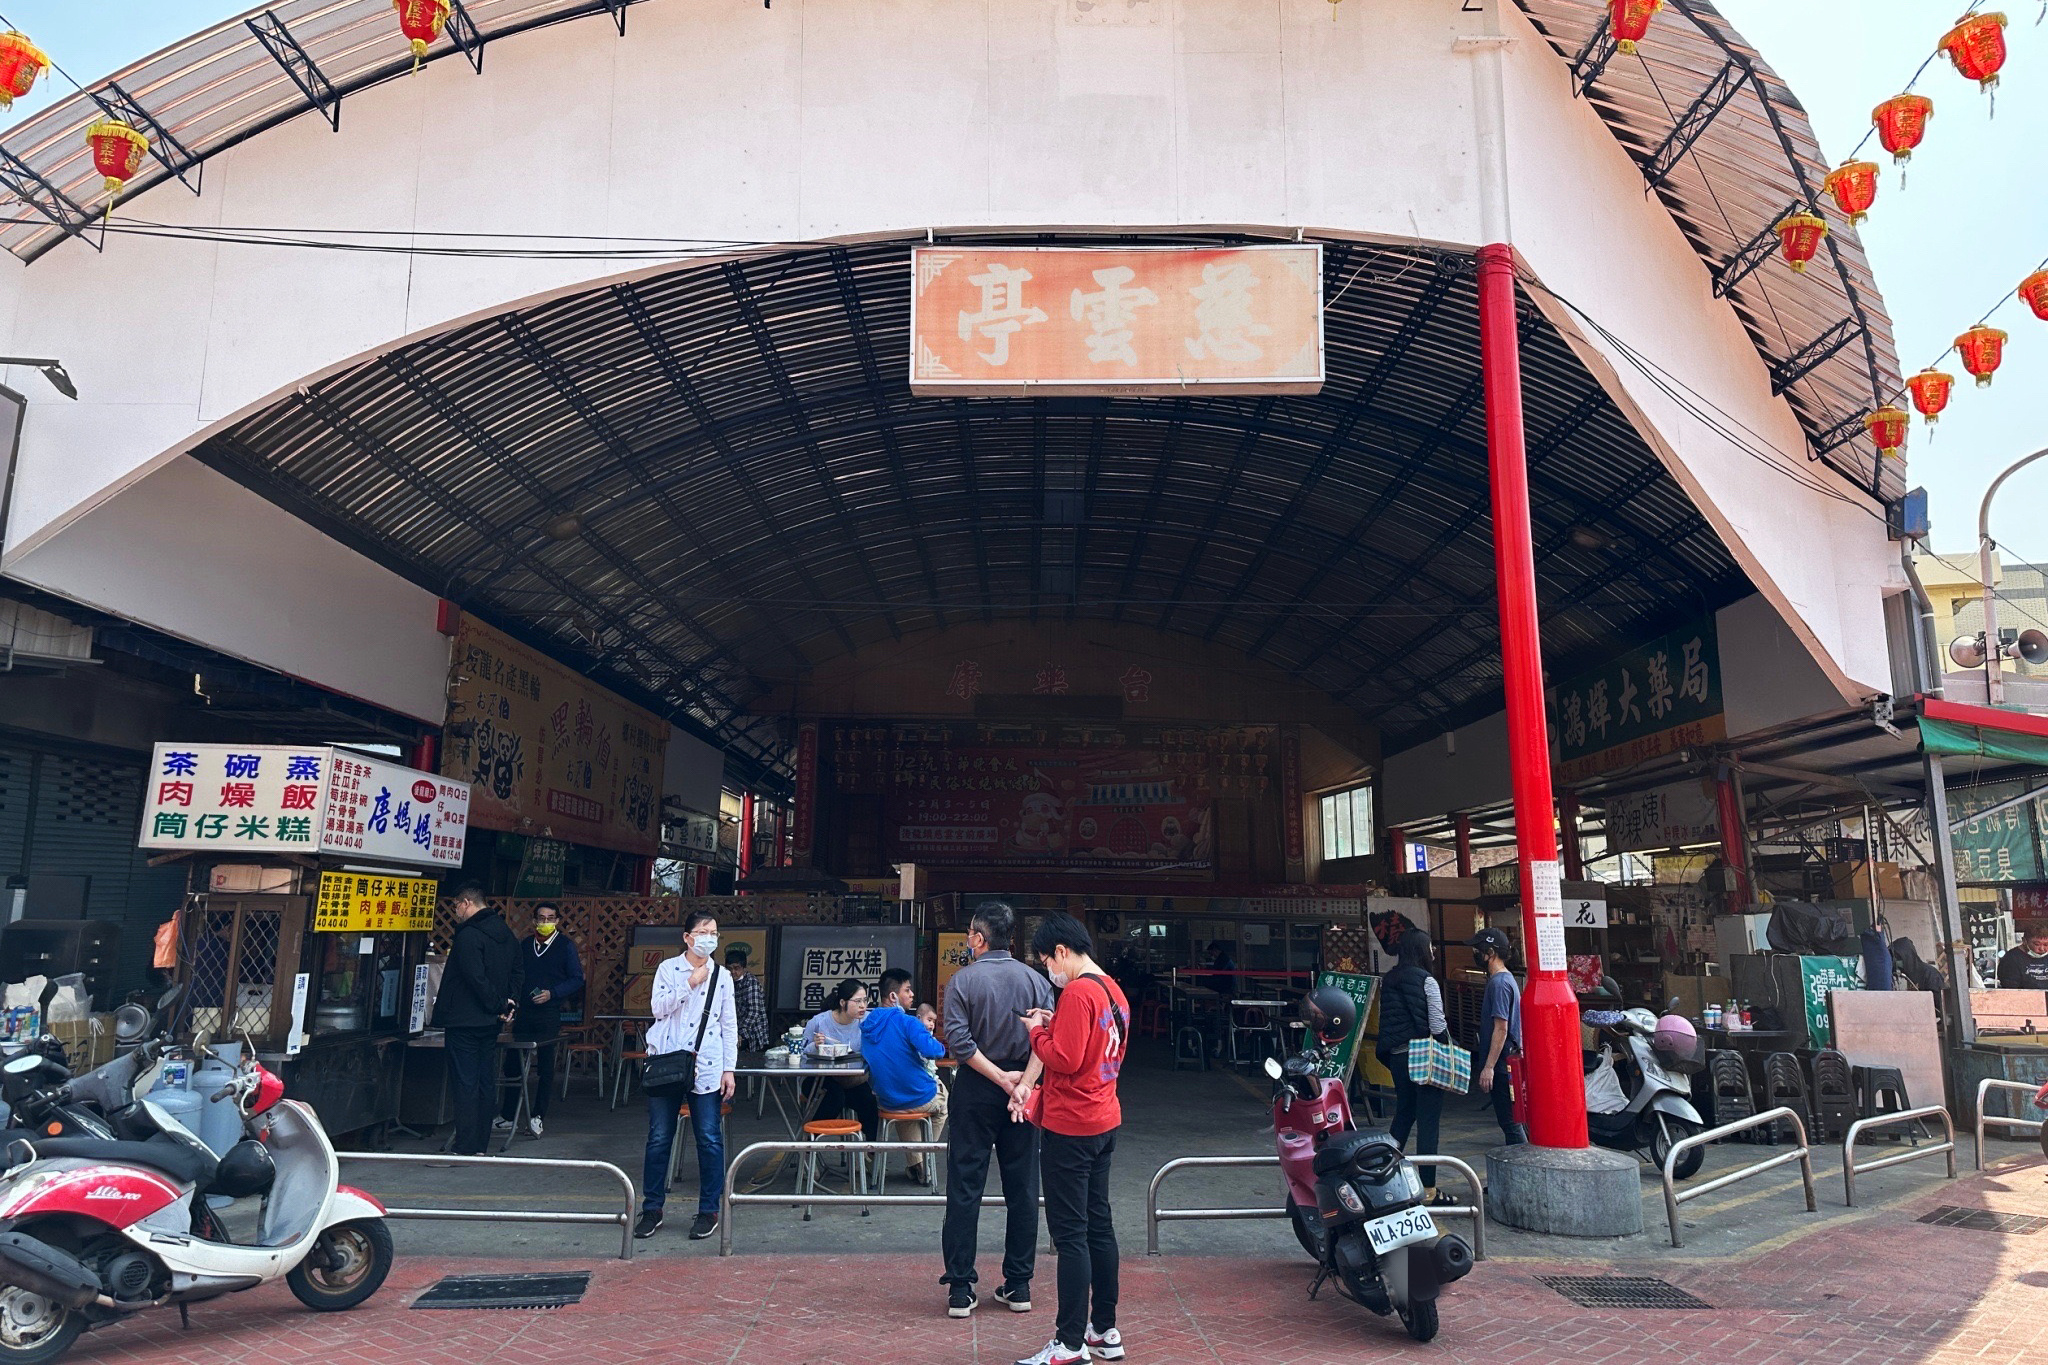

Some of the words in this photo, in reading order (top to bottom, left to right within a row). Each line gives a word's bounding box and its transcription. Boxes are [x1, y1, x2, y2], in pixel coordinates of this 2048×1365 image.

[957, 262, 1273, 367] 慈雲亭
[162, 752, 322, 781] 茶碗蒸
[157, 780, 318, 811] 肉燥飯
[152, 812, 311, 842] 筒仔米糕
[324, 833, 333, 845] 40
[334, 835, 343, 846] 40
[344, 837, 353, 848] 40
[354, 838, 363, 849] 40
[432, 849, 439, 859] 40
[440, 850, 446, 860] 40
[447, 851, 454, 860] 15
[454, 852, 460, 861] 40
[356, 878, 409, 898] 筒仔米糕
[1575, 901, 1596, 925] 花
[317, 919, 326, 928] 40
[328, 919, 337, 928] 40
[339, 919, 348, 928] 40
[417, 920, 424, 928] 40
[425, 920, 432, 928] 40
[804, 949, 882, 976] 筒仔米糕
[85, 1185, 123, 1199] Mio
